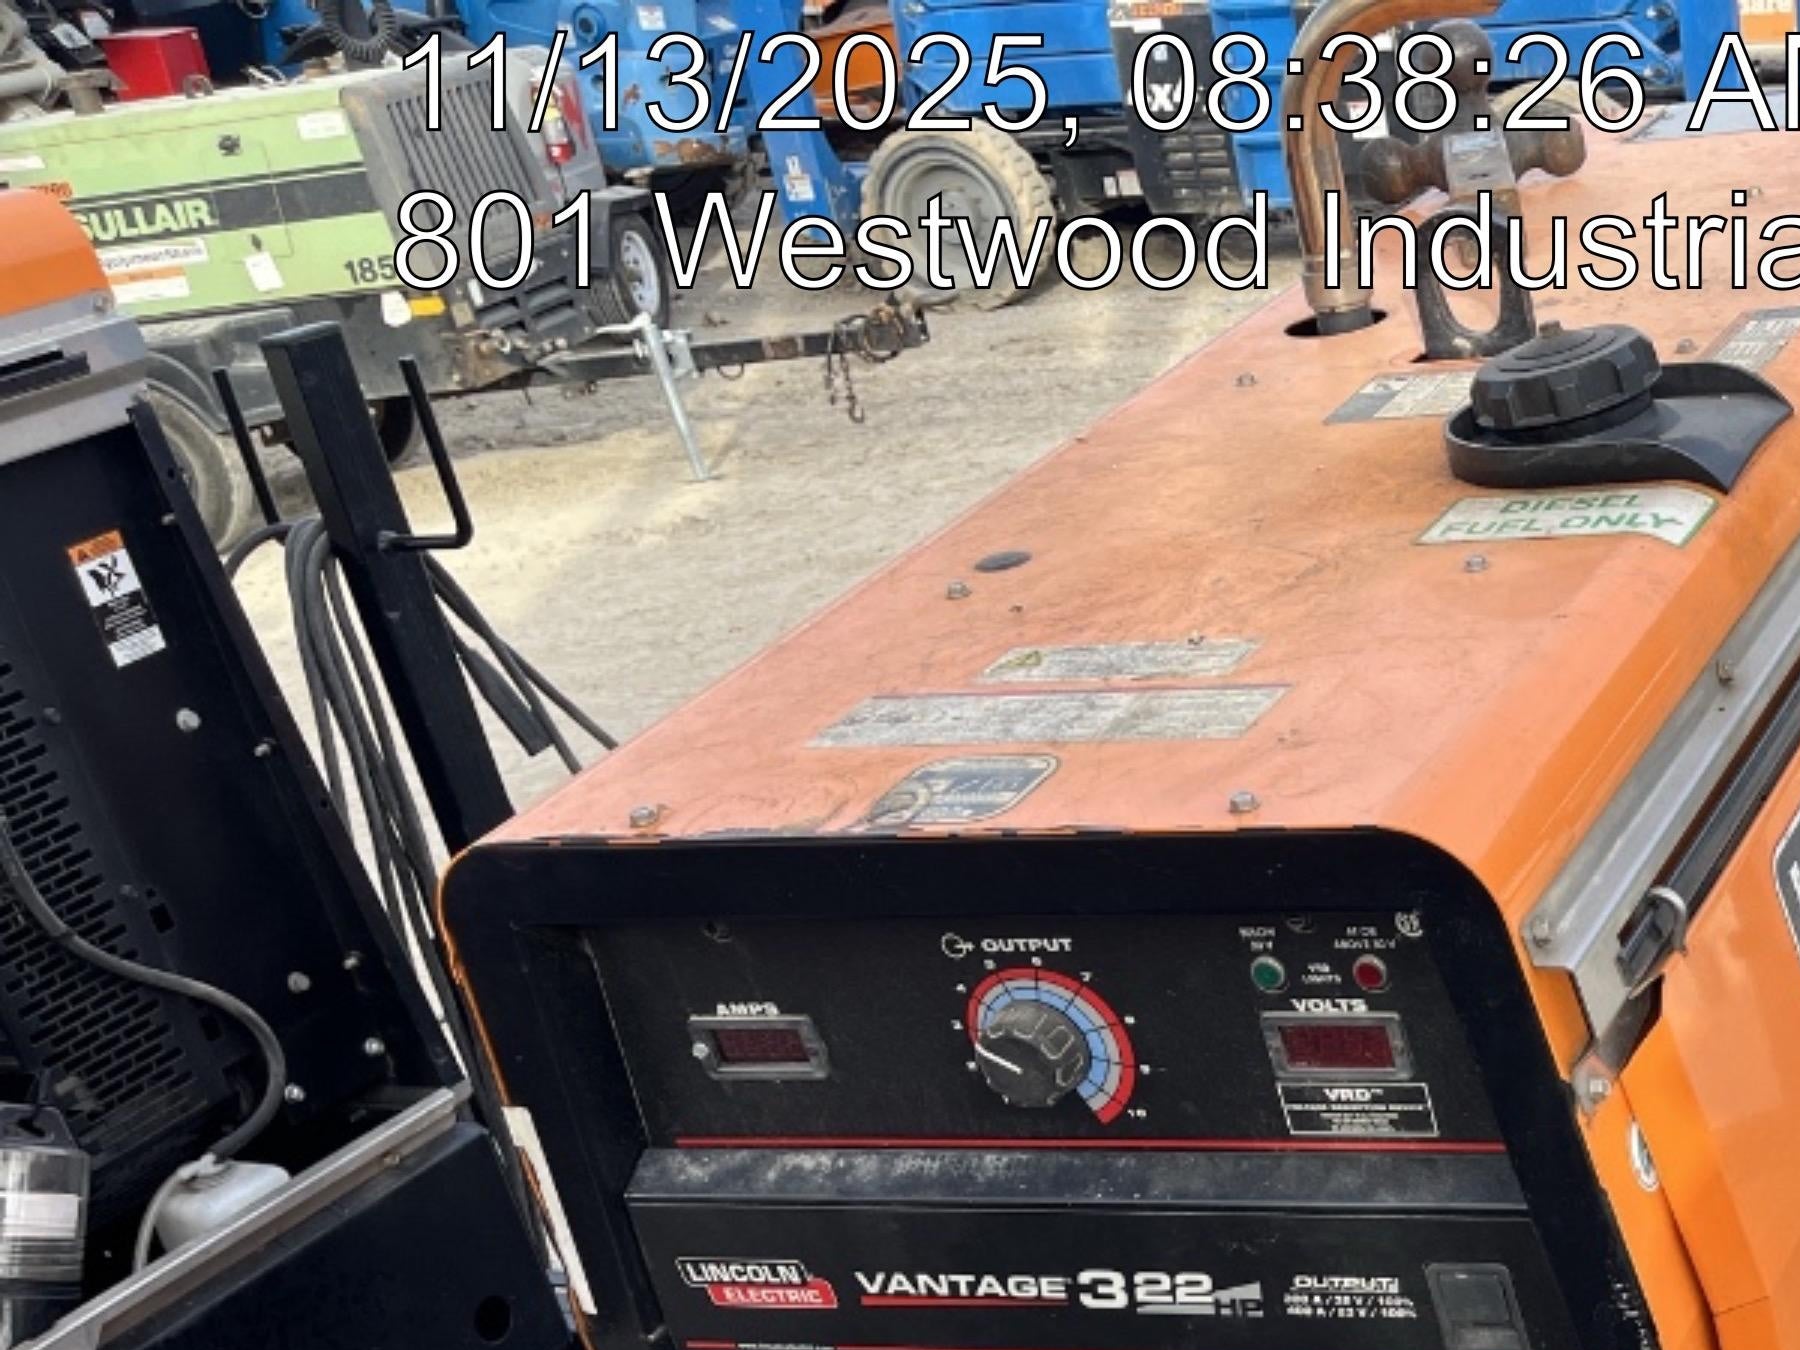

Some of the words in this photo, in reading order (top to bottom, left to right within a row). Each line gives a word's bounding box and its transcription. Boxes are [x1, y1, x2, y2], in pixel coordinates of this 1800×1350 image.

[1500, 493, 1646, 514] DIESEL
[1439, 518, 1545, 538] FUEL
[1558, 511, 1684, 530] ONLY
[980, 938, 1073, 952] OUTPUT
[1289, 998, 1369, 1013] VOLTS
[686, 1262, 802, 1284] LINCOLN
[721, 1286, 824, 1304] ELECTRIC
[854, 1270, 1068, 1298] VANTAGE
[1077, 1267, 1214, 1310] 322
